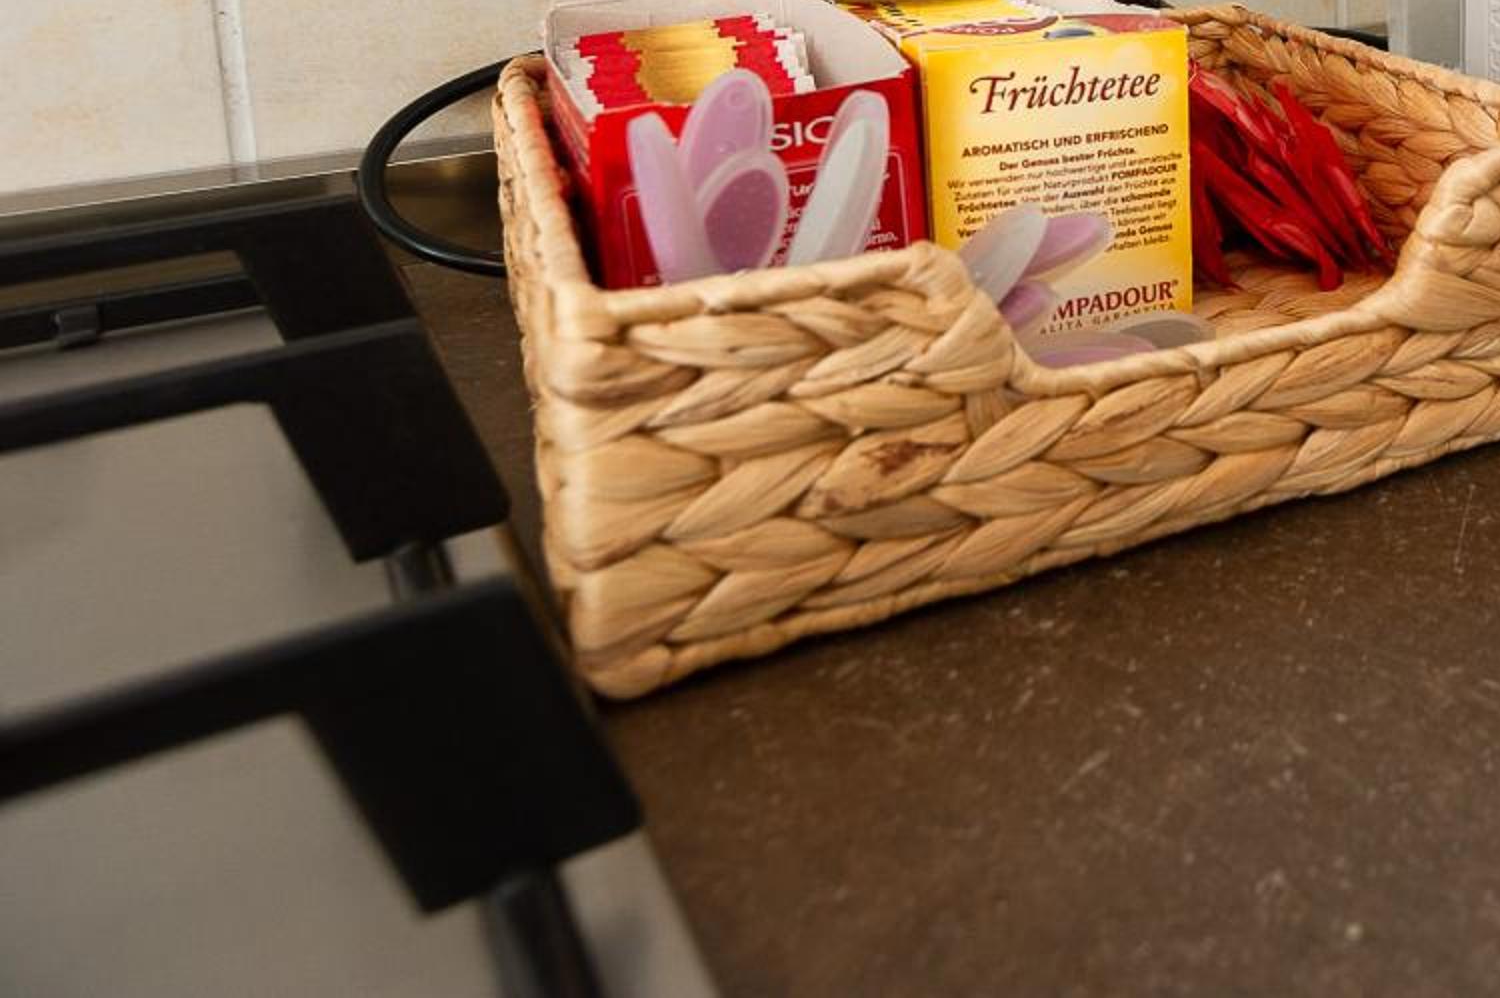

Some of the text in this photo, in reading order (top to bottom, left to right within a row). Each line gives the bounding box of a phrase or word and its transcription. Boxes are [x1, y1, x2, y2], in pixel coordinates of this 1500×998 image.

[969, 65, 1162, 115] Früchtetee
[962, 123, 1169, 158] AROMATISCH UND ERFRISCHEND
[998, 160, 1019, 171] Der
[1052, 281, 1174, 322] MPADOUR
